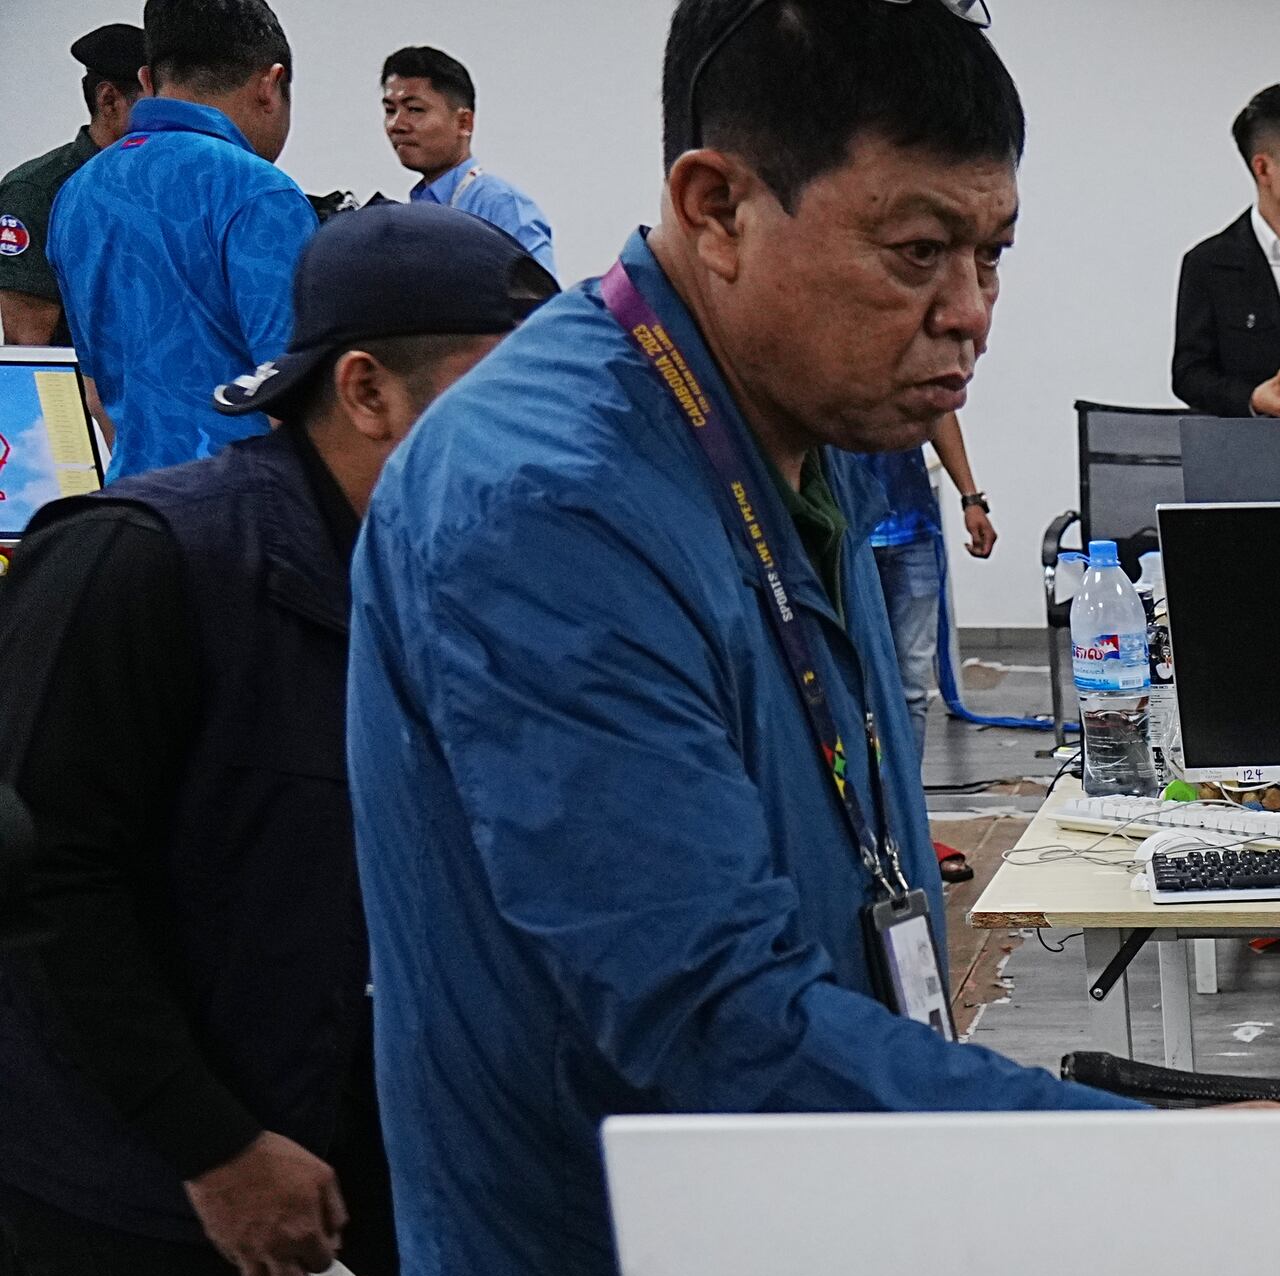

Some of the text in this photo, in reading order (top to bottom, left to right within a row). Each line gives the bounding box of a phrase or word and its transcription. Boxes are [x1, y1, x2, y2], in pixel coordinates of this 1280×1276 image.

[632, 323, 706, 428] CAMBODIA 2023
[730, 480, 794, 623] SPORTS LIVE IN PEACE
[1243, 768, 1264, 781] 124
